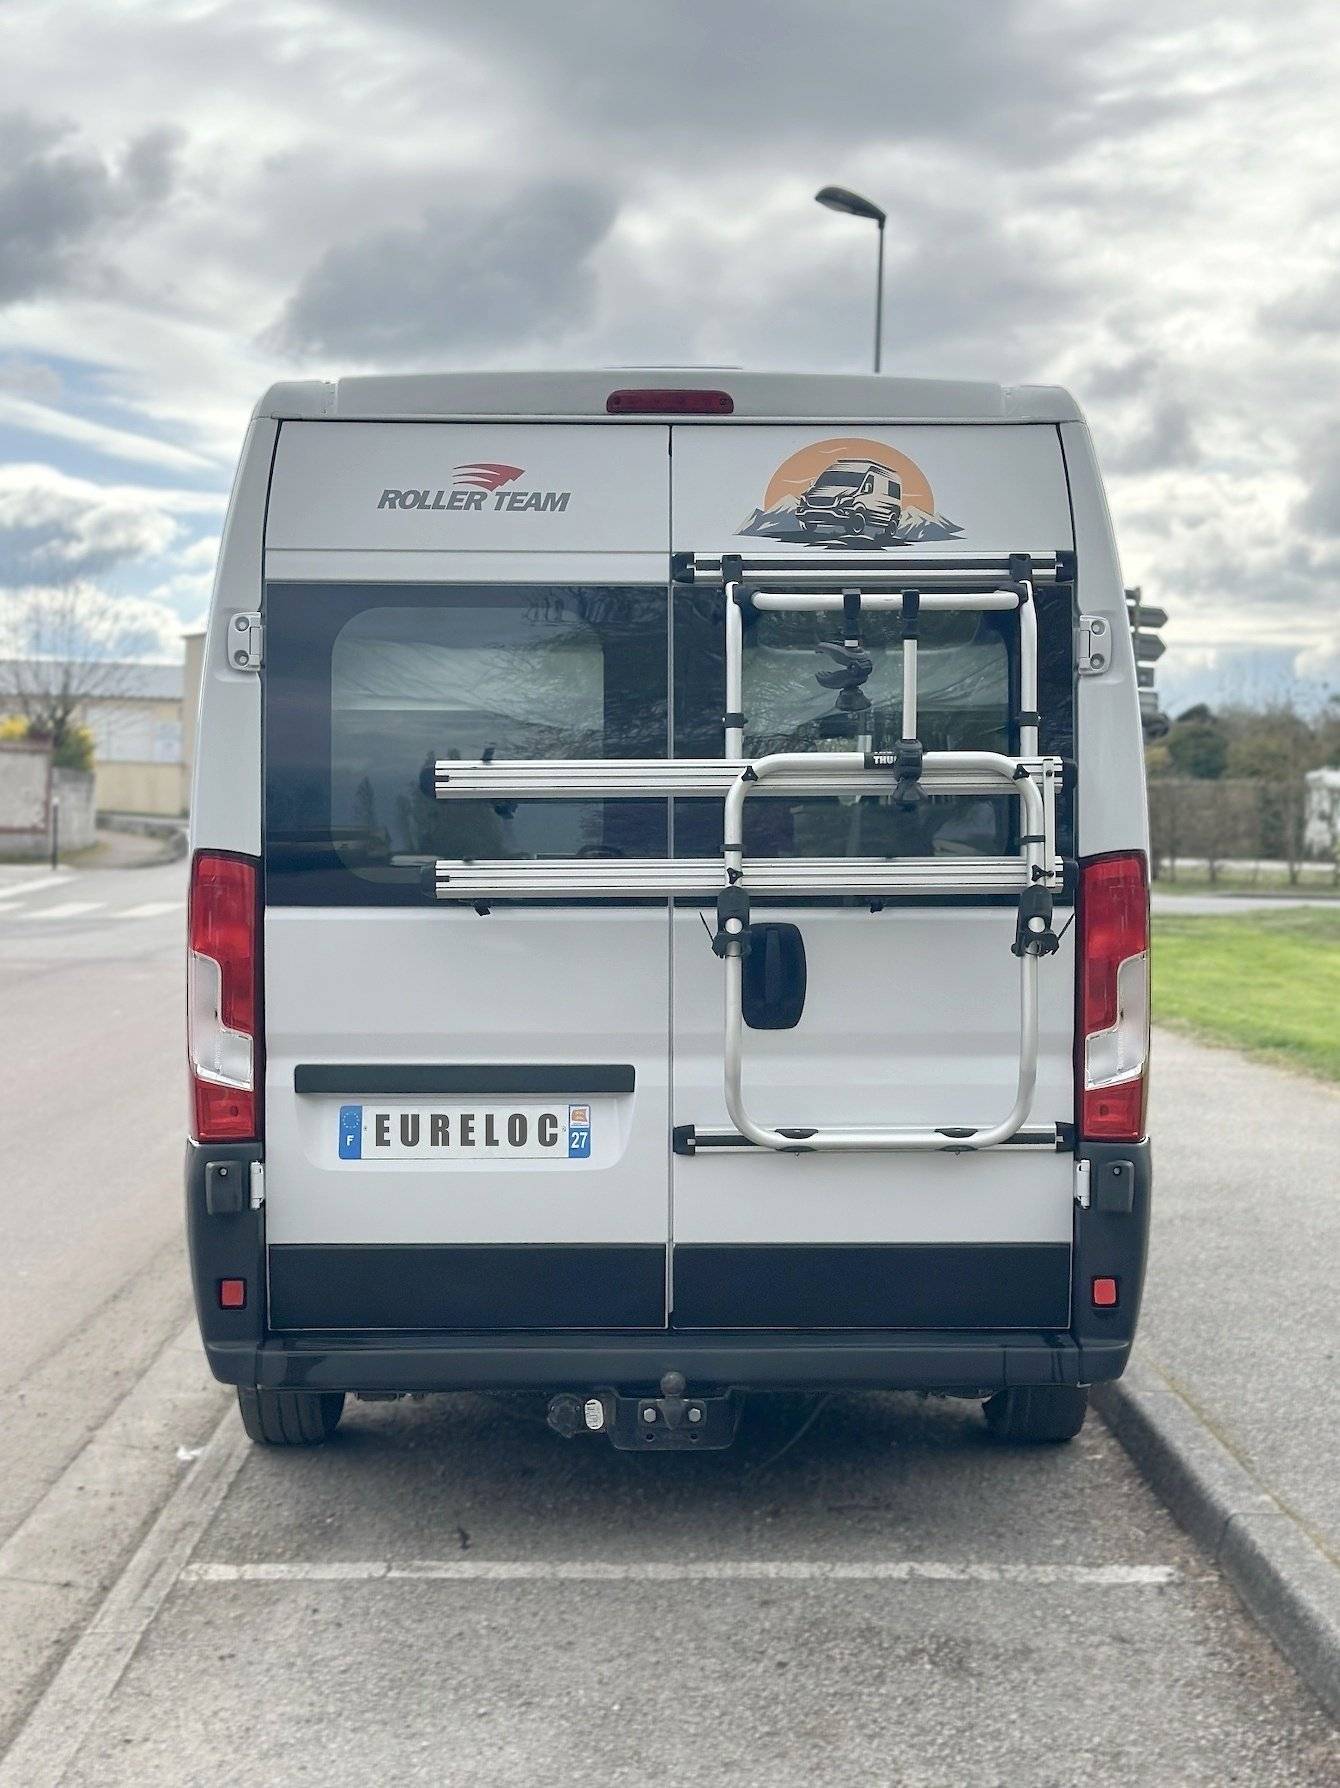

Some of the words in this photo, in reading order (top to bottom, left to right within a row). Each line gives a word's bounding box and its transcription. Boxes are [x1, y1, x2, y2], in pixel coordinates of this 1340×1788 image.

[377, 489, 488, 511] ROLLER
[494, 491, 572, 512] TEAM
[375, 1113, 558, 1147] EURELOC
[571, 1131, 588, 1149] 27
[346, 1135, 354, 1148] F
